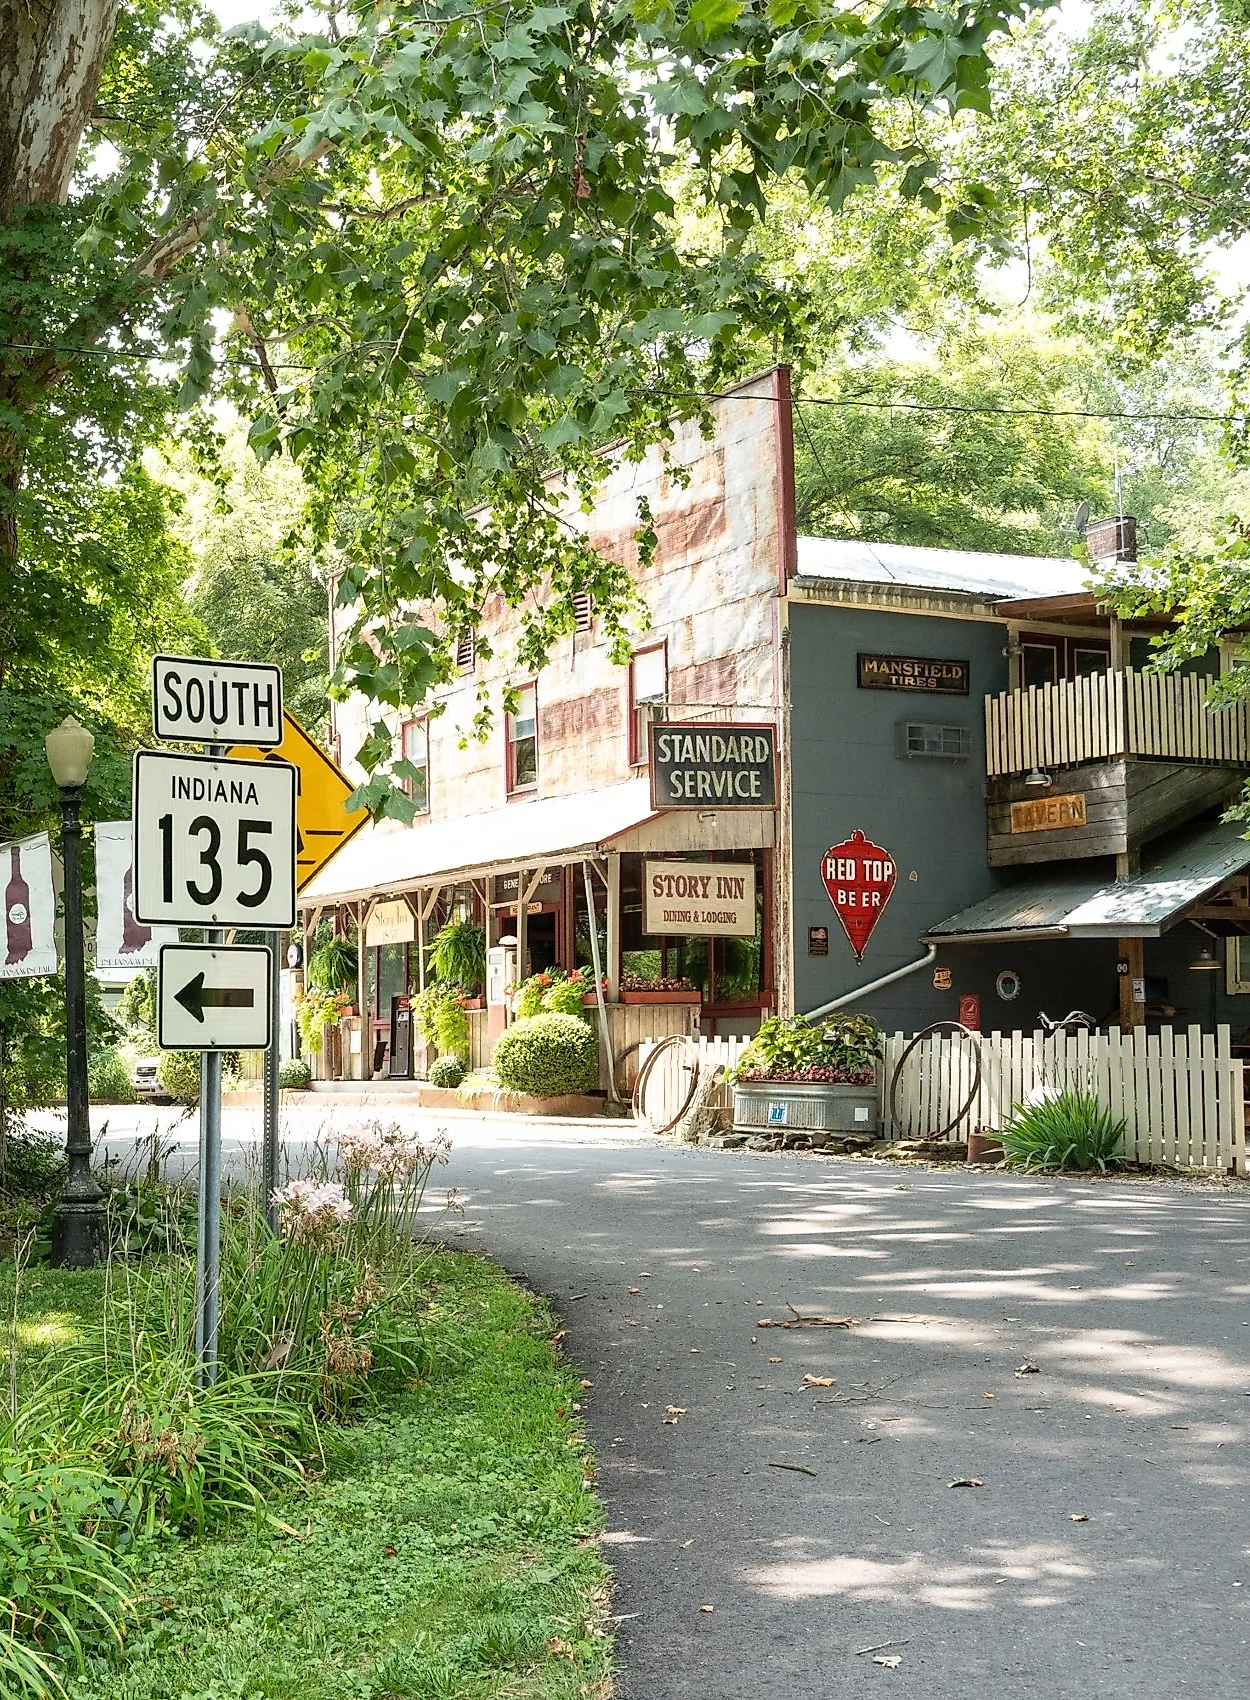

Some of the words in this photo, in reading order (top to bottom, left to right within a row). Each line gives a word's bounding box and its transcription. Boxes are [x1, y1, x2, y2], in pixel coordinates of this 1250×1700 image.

[864, 659, 962, 678] MANSFIELD
[889, 675, 937, 688] TIRES
[162, 671, 274, 728] SOUTH
[657, 734, 770, 763] STANDARD
[171, 775, 259, 805] INDIANA
[669, 770, 762, 798] SERVICE
[1012, 800, 1084, 829] TAVERN
[158, 813, 273, 907] 135
[826, 858, 856, 881] RED
[862, 859, 893, 883] TOP
[652, 874, 712, 899] STORY
[716, 876, 746, 900] INN
[837, 889, 881, 907] BEER
[663, 910, 692, 923] DINING
[693, 910, 700, 923] &
[701, 911, 738, 924] LODGING
